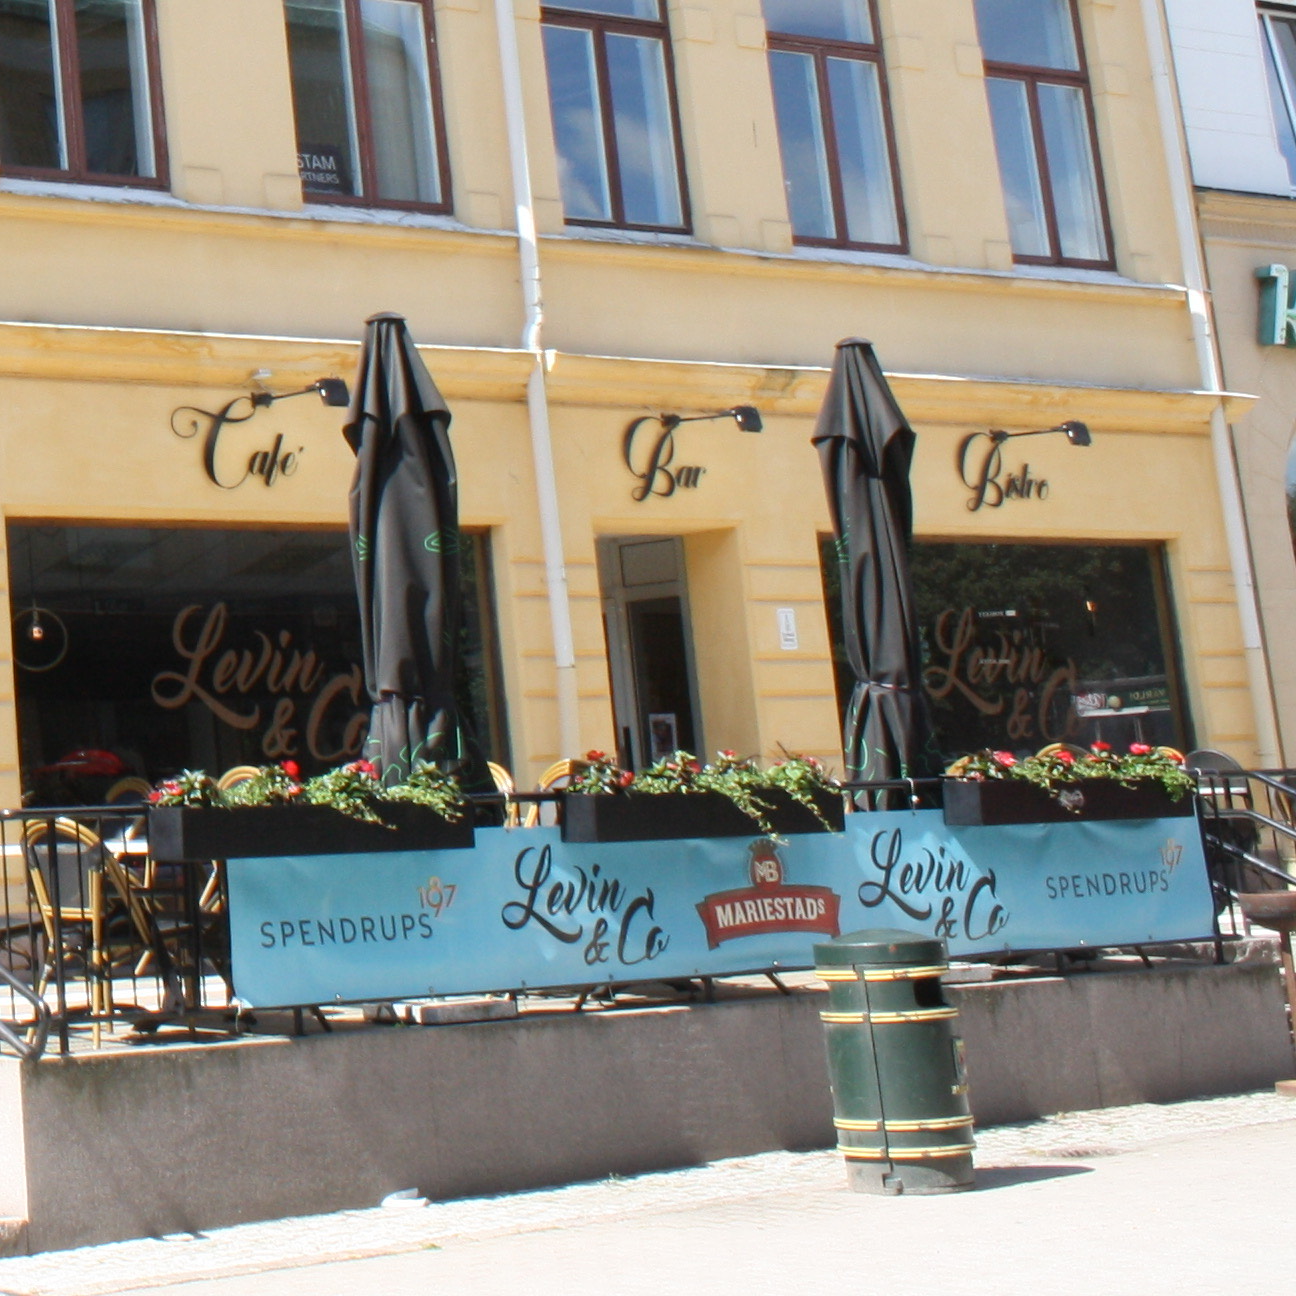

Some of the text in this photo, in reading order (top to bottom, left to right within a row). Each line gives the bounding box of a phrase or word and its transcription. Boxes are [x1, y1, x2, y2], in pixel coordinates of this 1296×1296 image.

[300, 171, 339, 183] RTNERS
[622, 415, 706, 501] Bar
[956, 432, 1049, 511] Bistro
[151, 602, 323, 730] Levin
[922, 607, 1046, 715] Levin
[262, 698, 299, 759] &
[1008, 688, 1035, 740] &
[501, 843, 626, 944] Levin
[858, 827, 971, 921] Levin
[934, 868, 1010, 941] & Co
[1045, 868, 1170, 900] SPENDRUPS
[259, 912, 433, 949] SPENDRUPS
[584, 887, 670, 966] & Co
